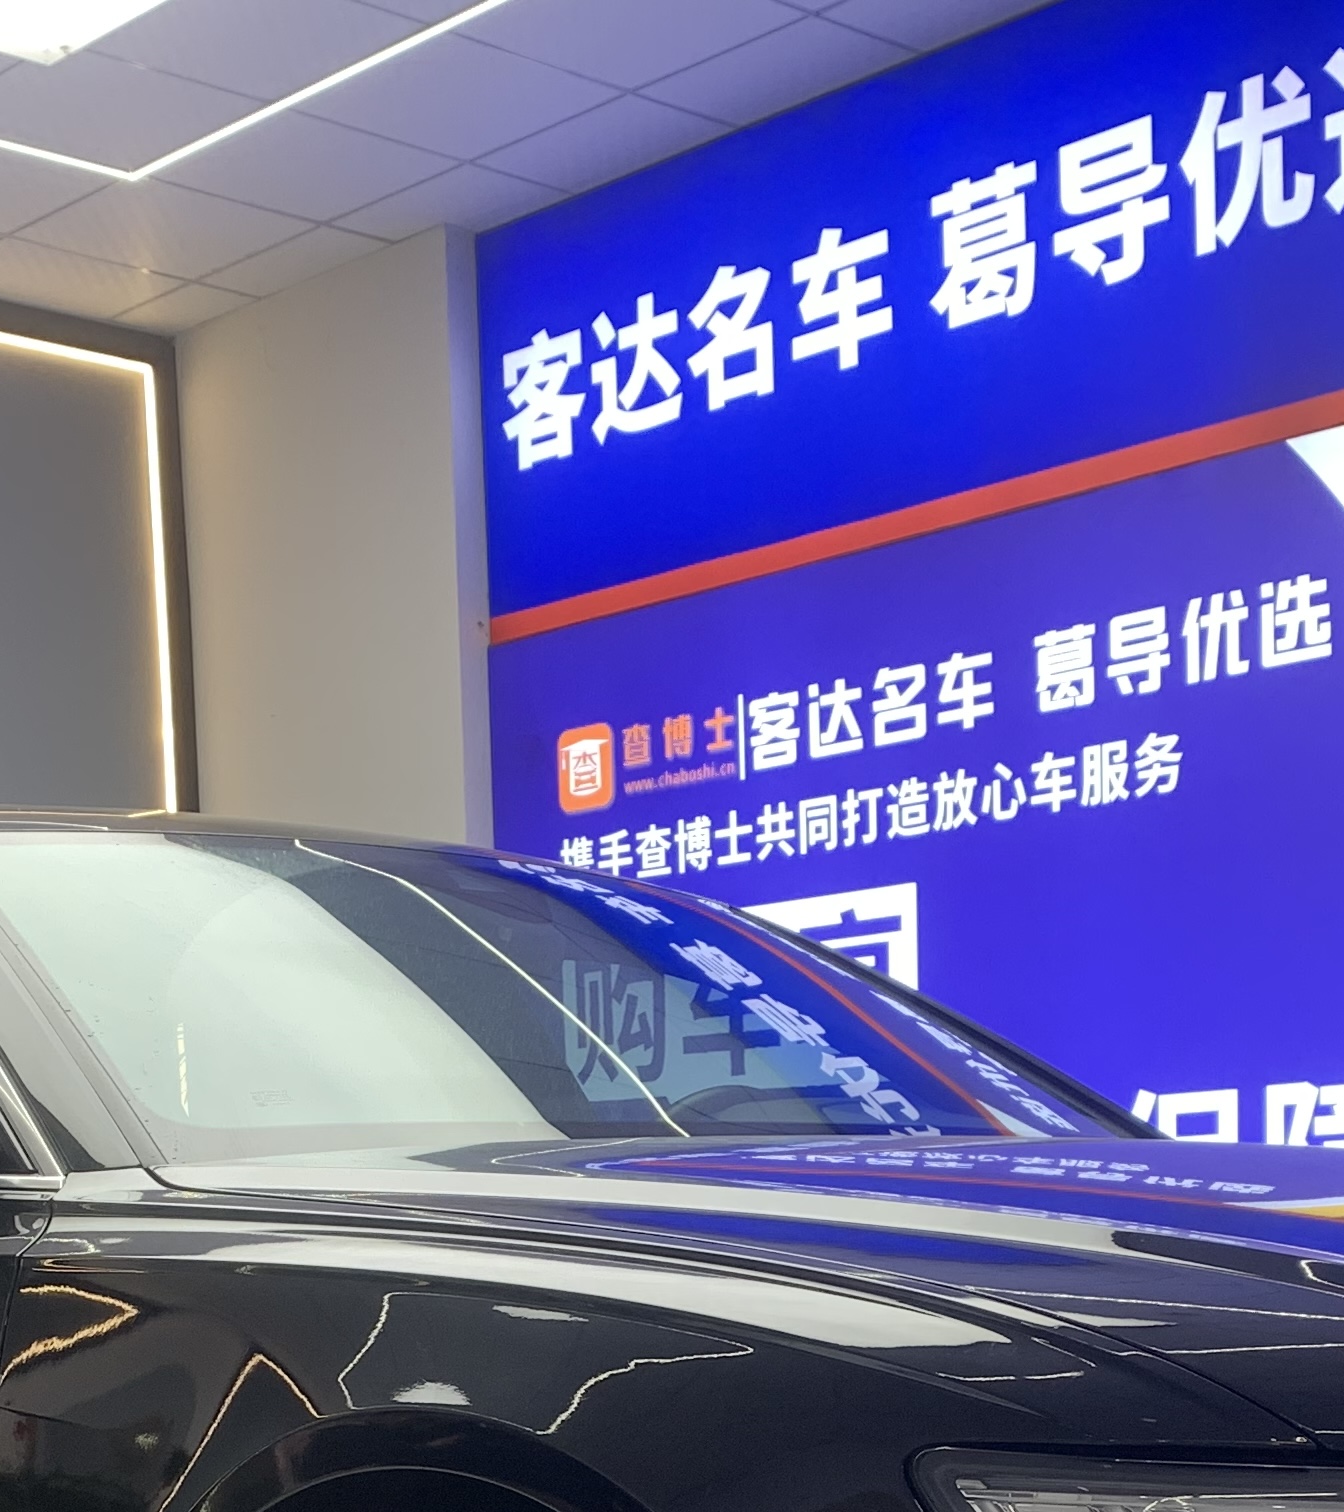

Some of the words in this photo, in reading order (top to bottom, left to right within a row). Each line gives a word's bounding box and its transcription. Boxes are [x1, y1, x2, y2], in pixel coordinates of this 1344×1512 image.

[501, 228, 894, 471] 客达名车
[747, 650, 994, 772] 客达名车
[1033, 574, 1333, 714] 葛导优选
[559, 732, 1184, 880] 携手查博士共同打造放心车服务
